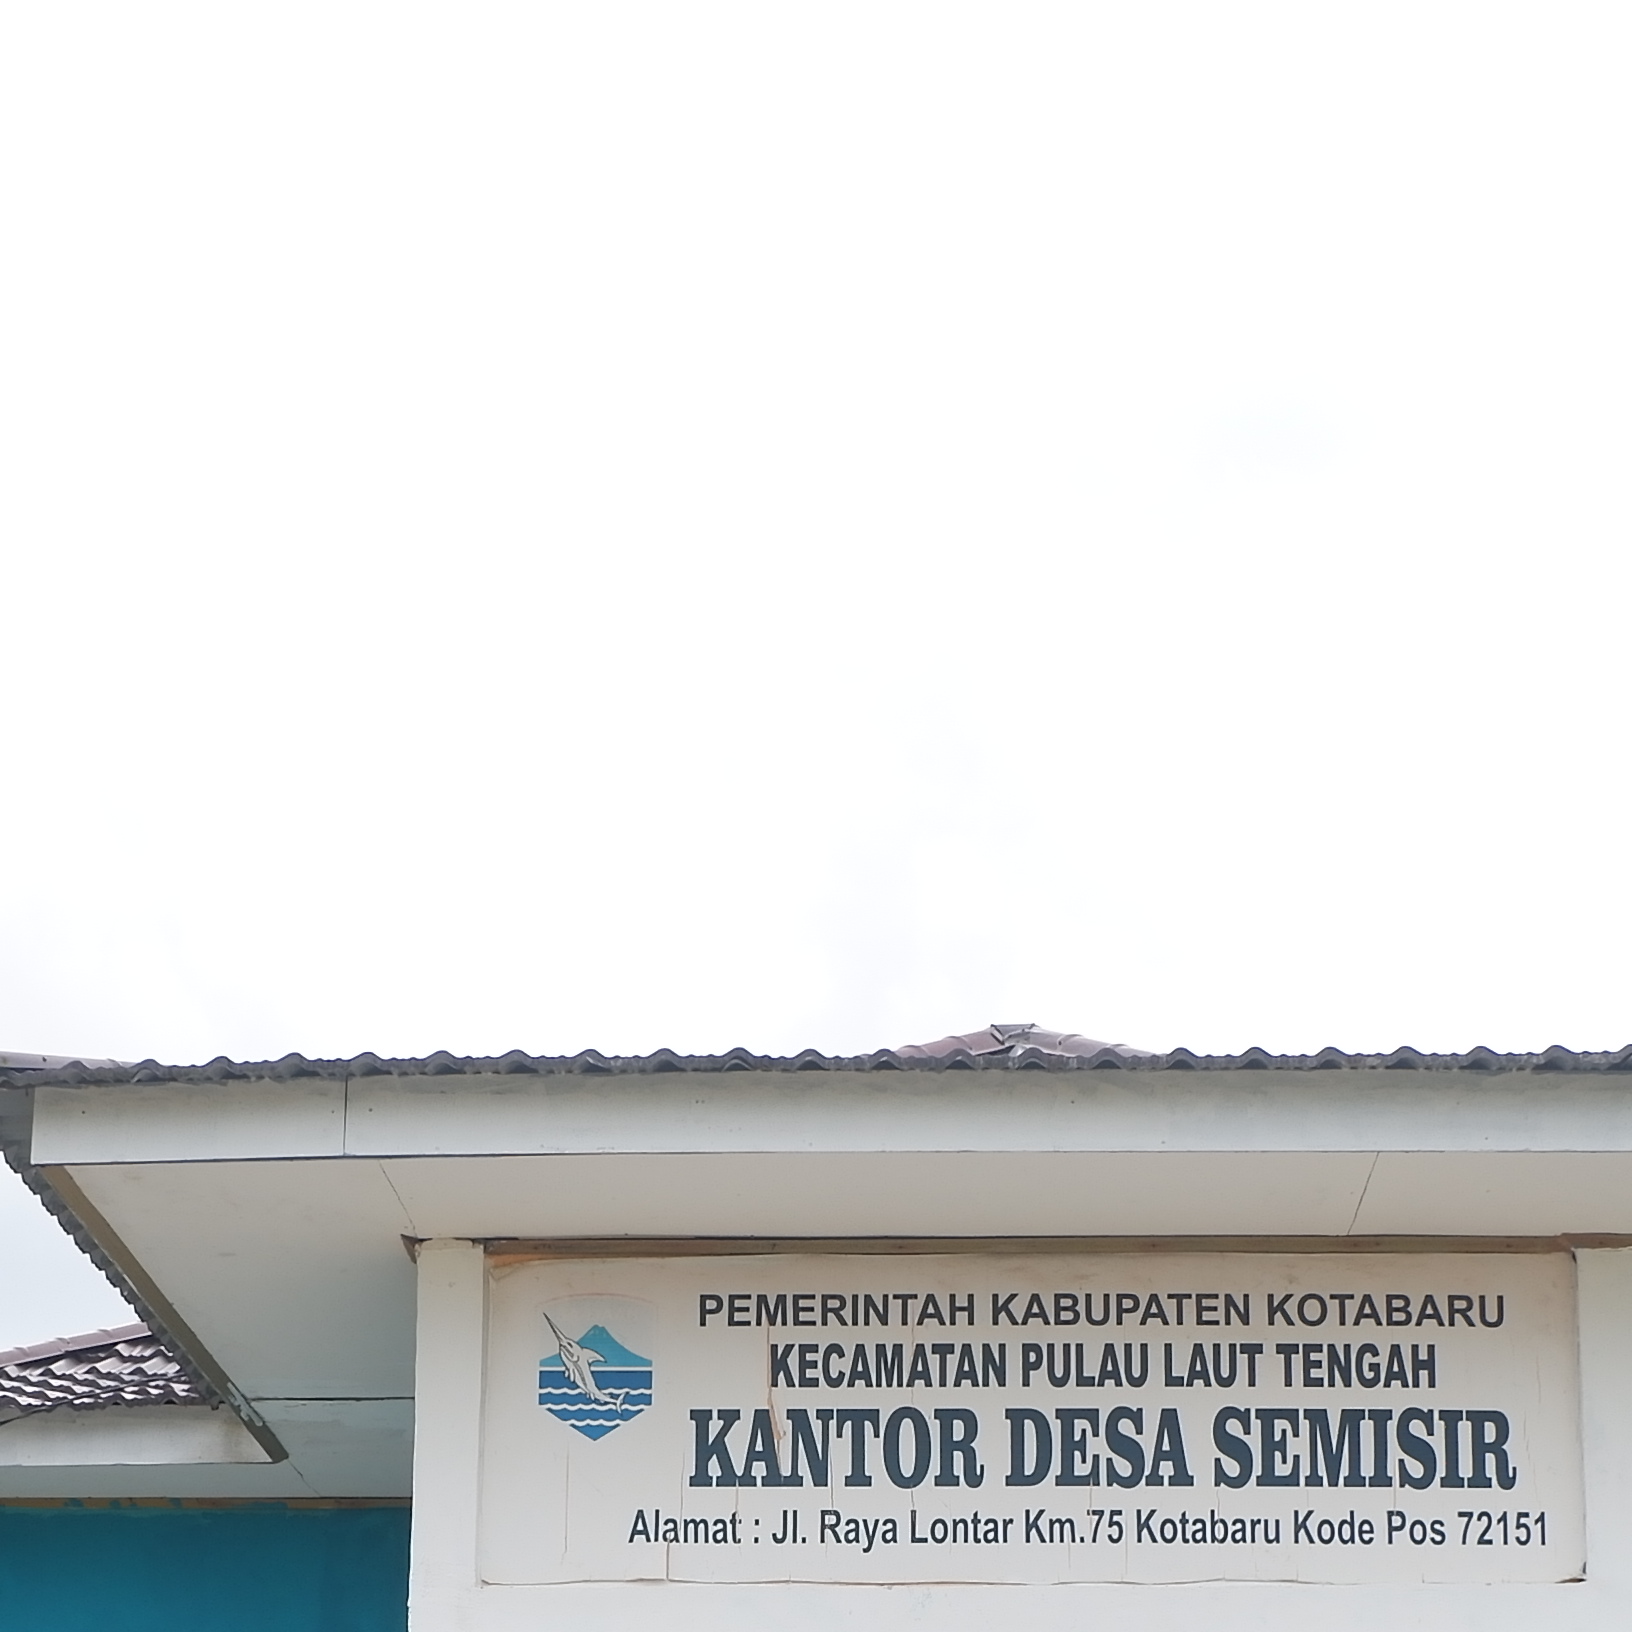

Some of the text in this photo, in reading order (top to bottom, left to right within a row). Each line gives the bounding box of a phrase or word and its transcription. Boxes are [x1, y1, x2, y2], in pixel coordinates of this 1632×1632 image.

[698, 1292, 1506, 1329] PEMERINTAH KABUPATEN KOTABARU
[770, 1342, 1437, 1389] KECAMATAN PULAU LAUT TENGAH
[687, 1406, 1518, 1491] KANTOR DESA SEMISIR
[628, 1508, 742, 1544] Alamat
[771, 1509, 808, 1544] Jl.
[820, 1509, 899, 1554] Raya
[909, 1509, 1015, 1544] Lontar
[1024, 1508, 1125, 1544] Km.75
[1136, 1508, 1282, 1545] Kotabaru
[1293, 1509, 1375, 1545] Kode
[1386, 1510, 1446, 1546] Pos
[1456, 1510, 1547, 1546] 72151
